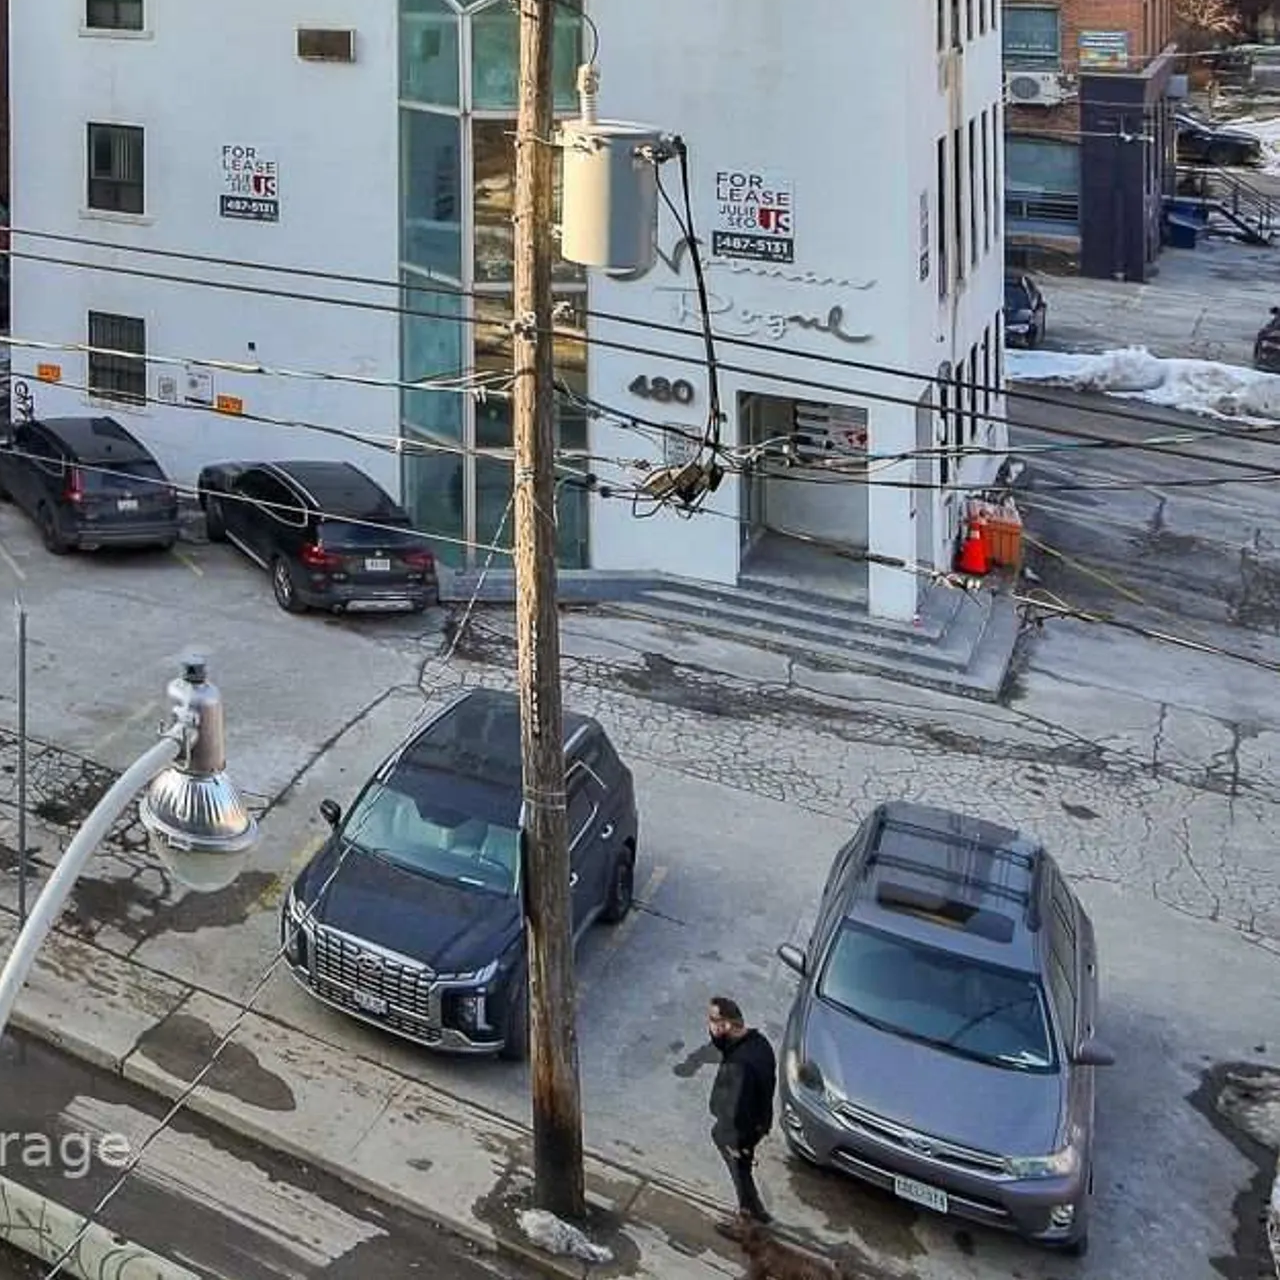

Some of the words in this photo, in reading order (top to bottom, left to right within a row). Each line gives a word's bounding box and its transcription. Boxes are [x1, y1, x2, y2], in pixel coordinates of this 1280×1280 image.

[222, 145, 256, 158] FOR
[223, 159, 276, 173] LEASE
[716, 172, 763, 189] FOR
[716, 187, 790, 206] LEASE
[628, 374, 696, 406] 480
